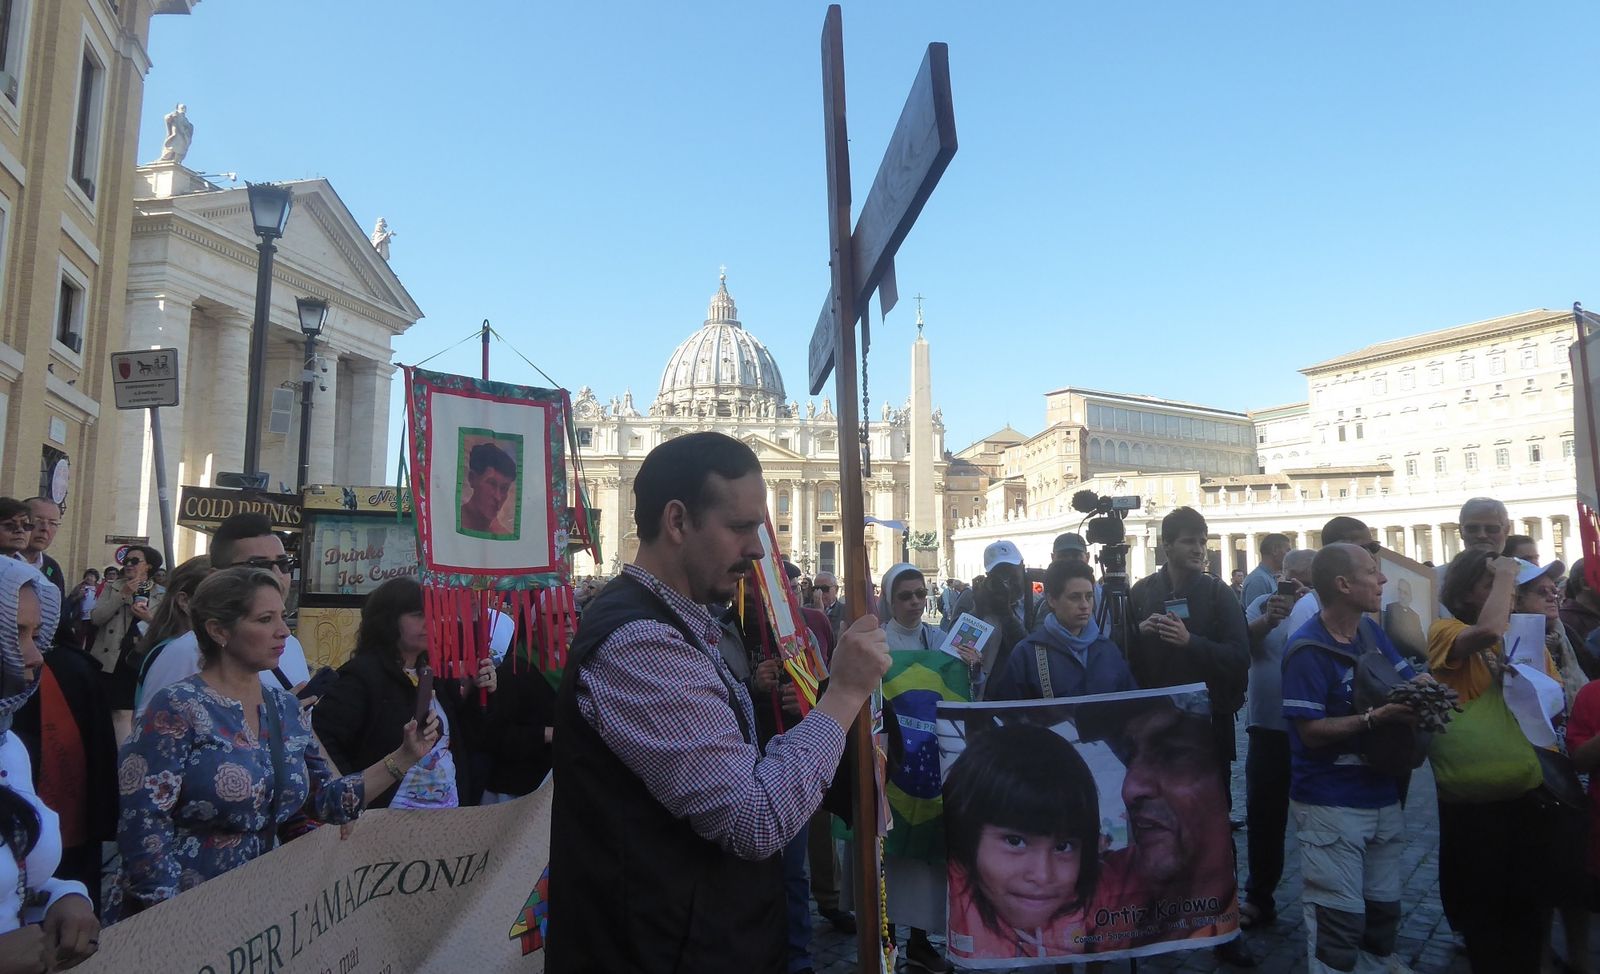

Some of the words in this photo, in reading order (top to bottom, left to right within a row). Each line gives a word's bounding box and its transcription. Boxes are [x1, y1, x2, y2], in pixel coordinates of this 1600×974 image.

[185, 496, 234, 519] COLD
[237, 499, 302, 524] DRINKS
[325, 544, 385, 566] Drinks
[338, 570, 365, 588] Ice
[369, 564, 419, 582] Cream
[227, 924, 283, 974] PER
[290, 849, 490, 960] L'AMAZZONIA
[1095, 905, 1146, 927] Ortiz
[339, 937, 359, 974] mai
